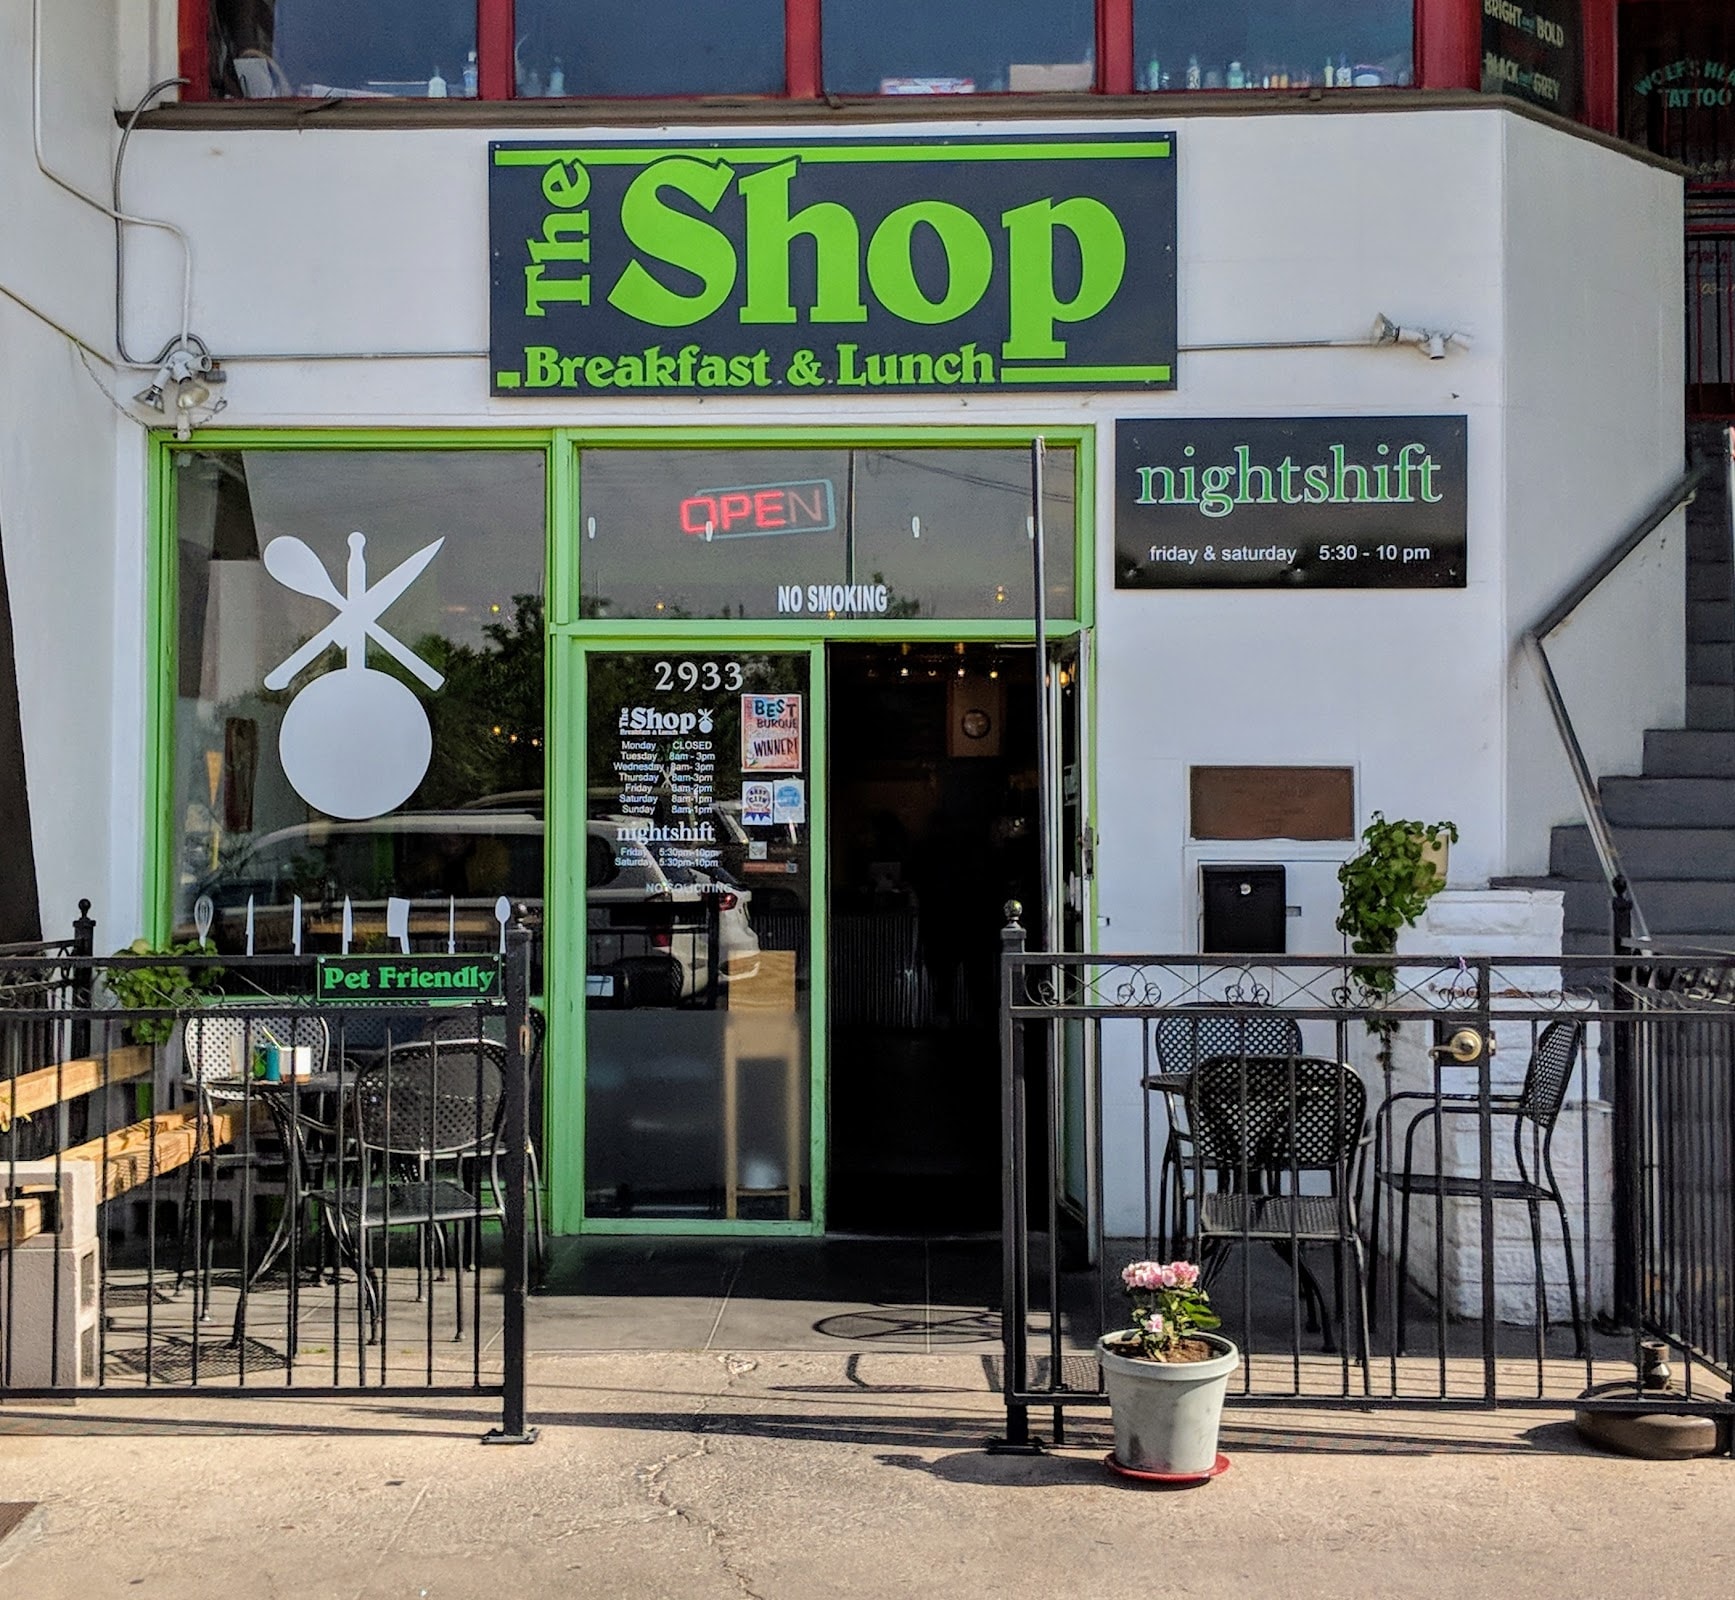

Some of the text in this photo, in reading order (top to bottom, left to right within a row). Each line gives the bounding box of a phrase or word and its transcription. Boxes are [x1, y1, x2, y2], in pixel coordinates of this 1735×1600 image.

[1484, 0, 1523, 28] BRIGHT
[1536, 14, 1564, 48] BOLD
[525, 156, 1126, 359] The Shop
[524, 343, 994, 389] Breakfast & Lunch
[1136, 444, 1444, 517] nightshift
[680, 489, 823, 535] OPEN
[1150, 546, 1198, 563] friday
[1203, 547, 1216, 561] &
[1222, 546, 1297, 564] saturday
[1319, 546, 1358, 561] 5:30
[1376, 546, 1397, 561] 10
[1403, 548, 1431, 564] pm
[778, 585, 887, 613] NO SMOKING
[654, 661, 744, 692] 2933
[754, 699, 797, 718] BEST
[629, 707, 697, 734] Shop
[621, 741, 712, 751] Monday CLOSED
[621, 751, 658, 762] Tuesday
[696, 752, 716, 762] 3pm
[613, 762, 664, 772] Wednesday
[619, 772, 660, 783] Thursday
[625, 783, 653, 794] Friday
[619, 794, 658, 804] Saturday
[622, 804, 655, 815] Sunday
[616, 821, 716, 845] nightshift
[621, 847, 649, 858] Friday
[614, 857, 653, 868] Saturday
[323, 966, 496, 992] Pet Friendly
